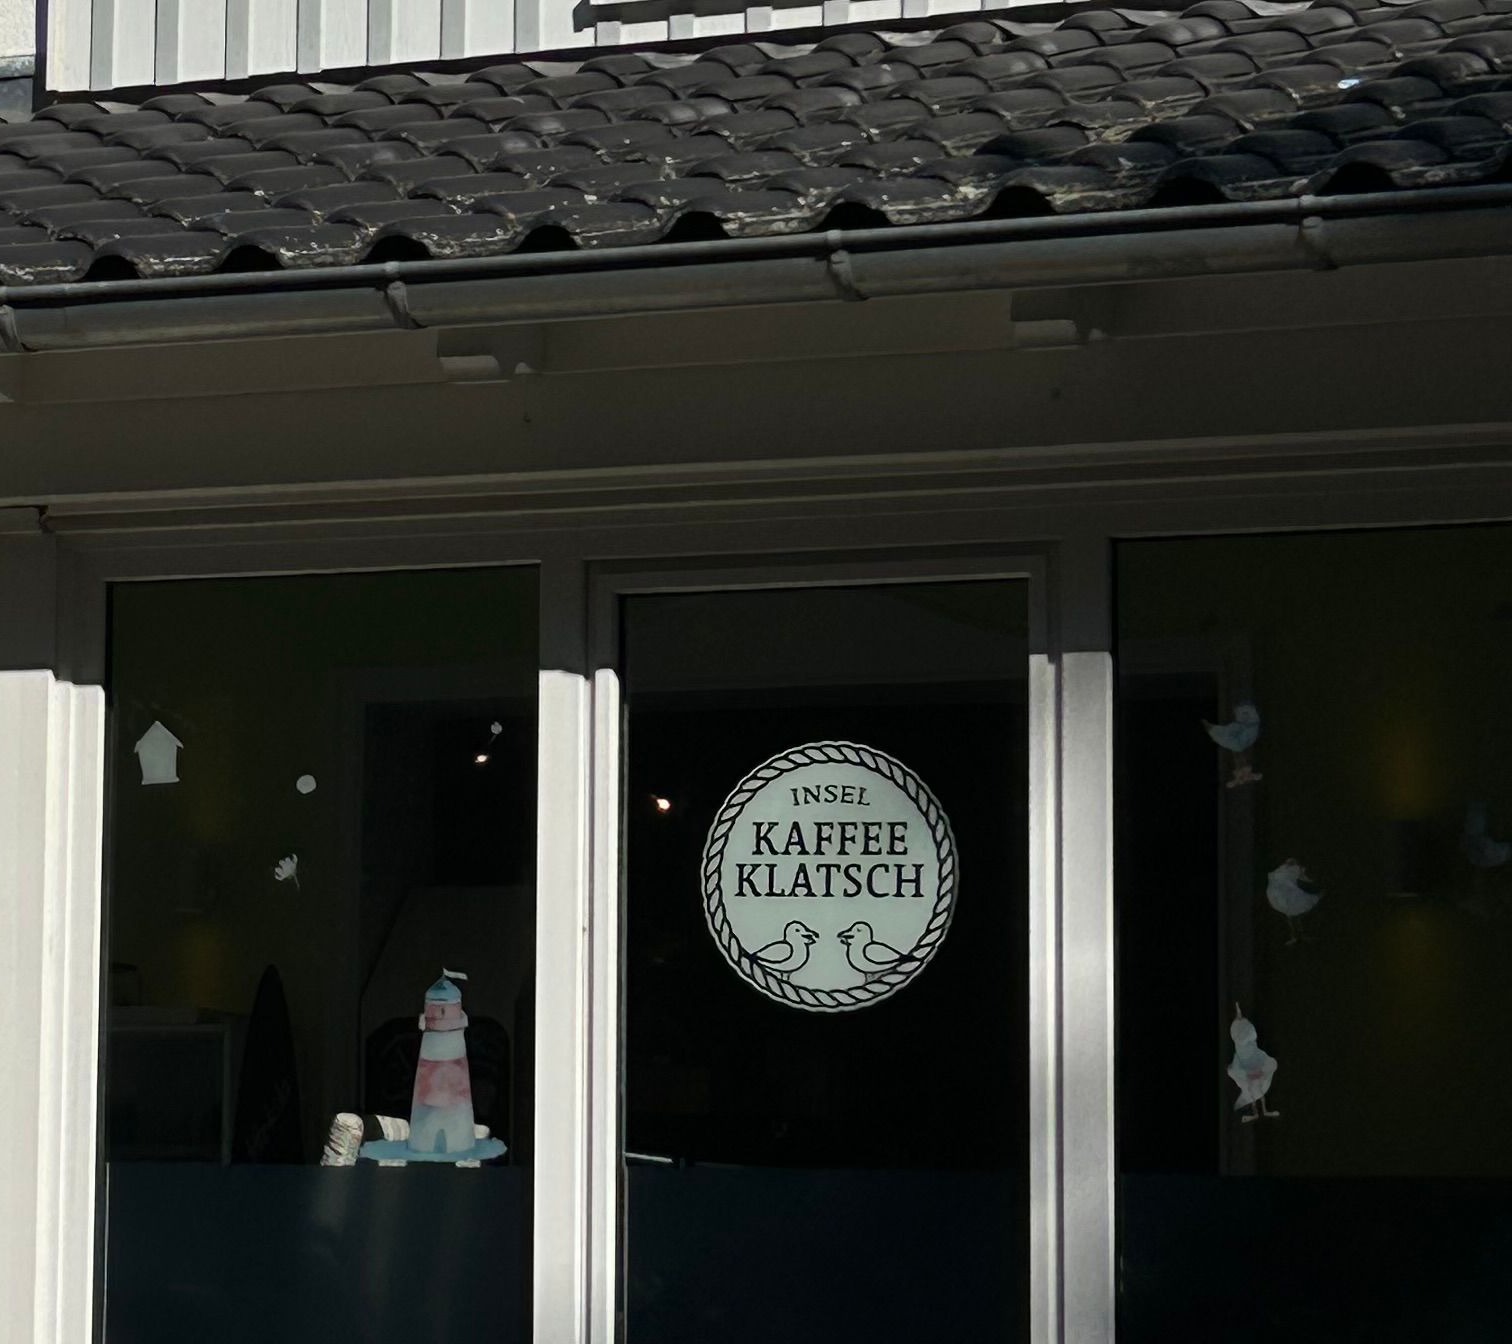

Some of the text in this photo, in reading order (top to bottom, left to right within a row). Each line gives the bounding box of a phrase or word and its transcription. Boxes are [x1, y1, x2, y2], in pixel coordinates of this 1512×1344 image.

[790, 784, 870, 806] INSEL
[752, 821, 908, 856] KAFFEE
[734, 862, 925, 898] KLATSCH
